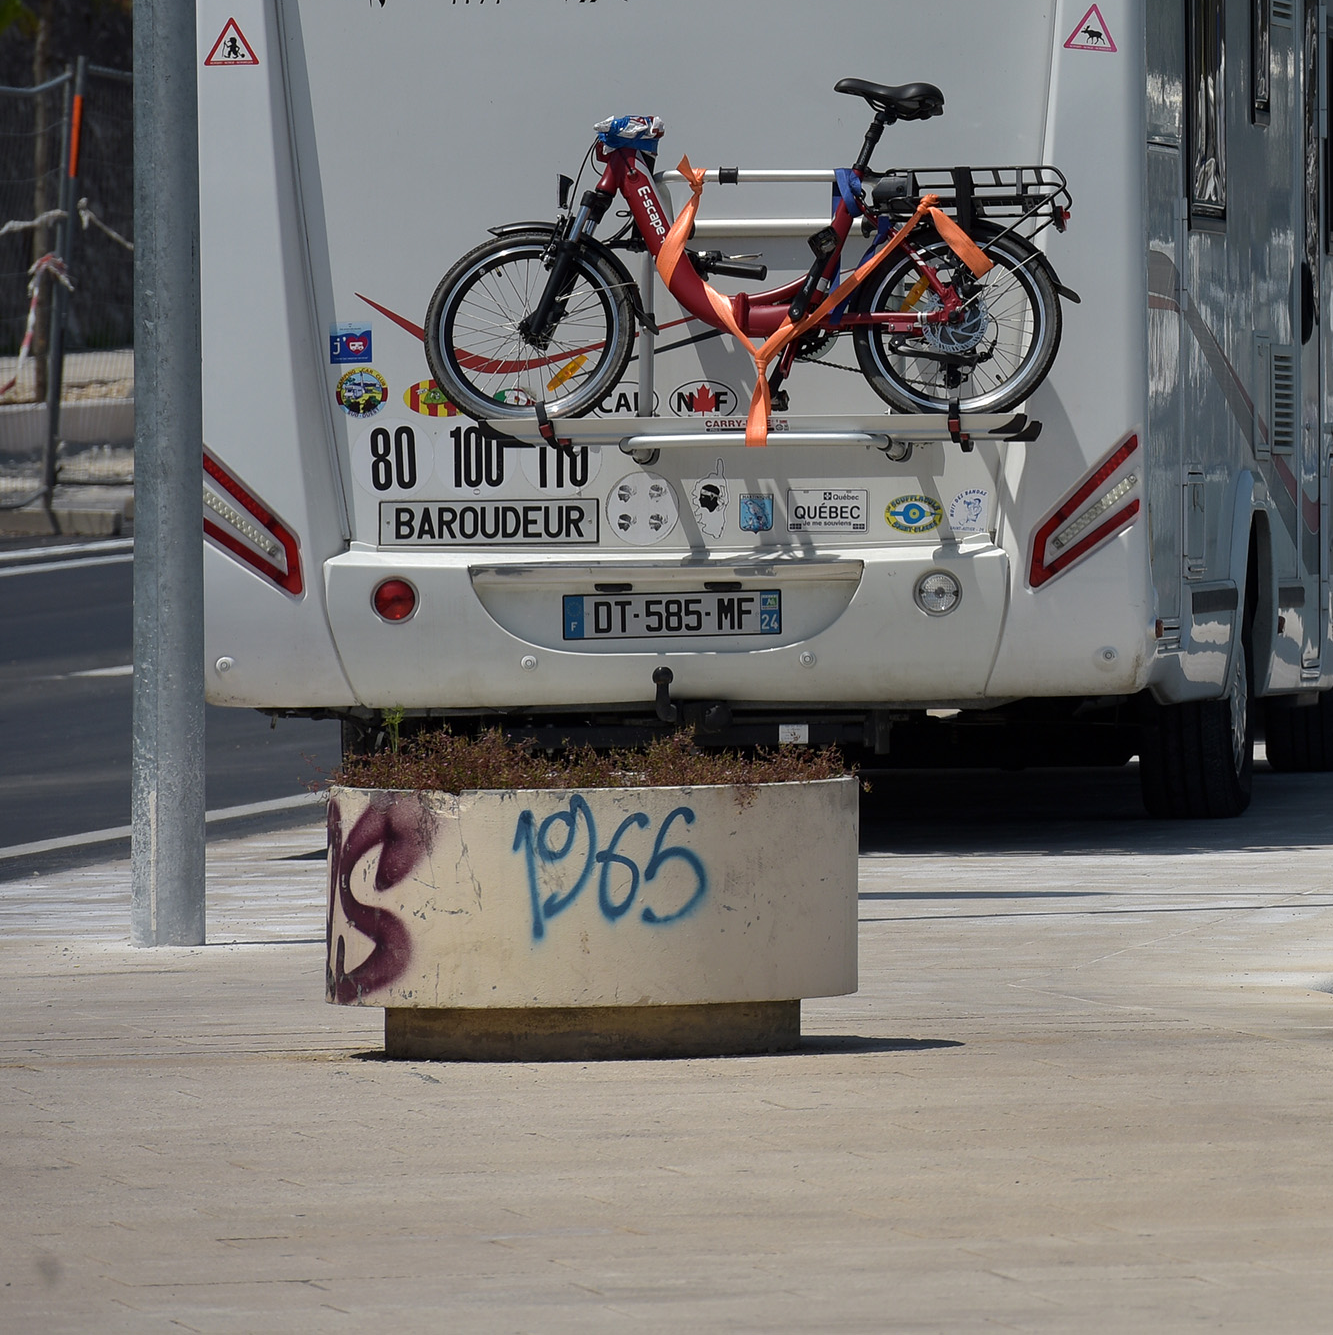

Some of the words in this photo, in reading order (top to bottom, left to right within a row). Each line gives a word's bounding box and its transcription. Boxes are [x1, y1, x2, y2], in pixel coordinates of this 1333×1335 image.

[336, 369, 356, 389] CAMPING
[375, 373, 387, 387] CLUB
[705, 419, 771, 427] CARRY-E
[370, 426, 417, 491] 80
[450, 426, 504, 488] 100
[832, 493, 860, 501] Québec
[794, 502, 861, 520] QUÉBEC
[394, 505, 585, 540] BAROUDEUR
[570, 622, 578, 632] F
[761, 613, 779, 630] 24
